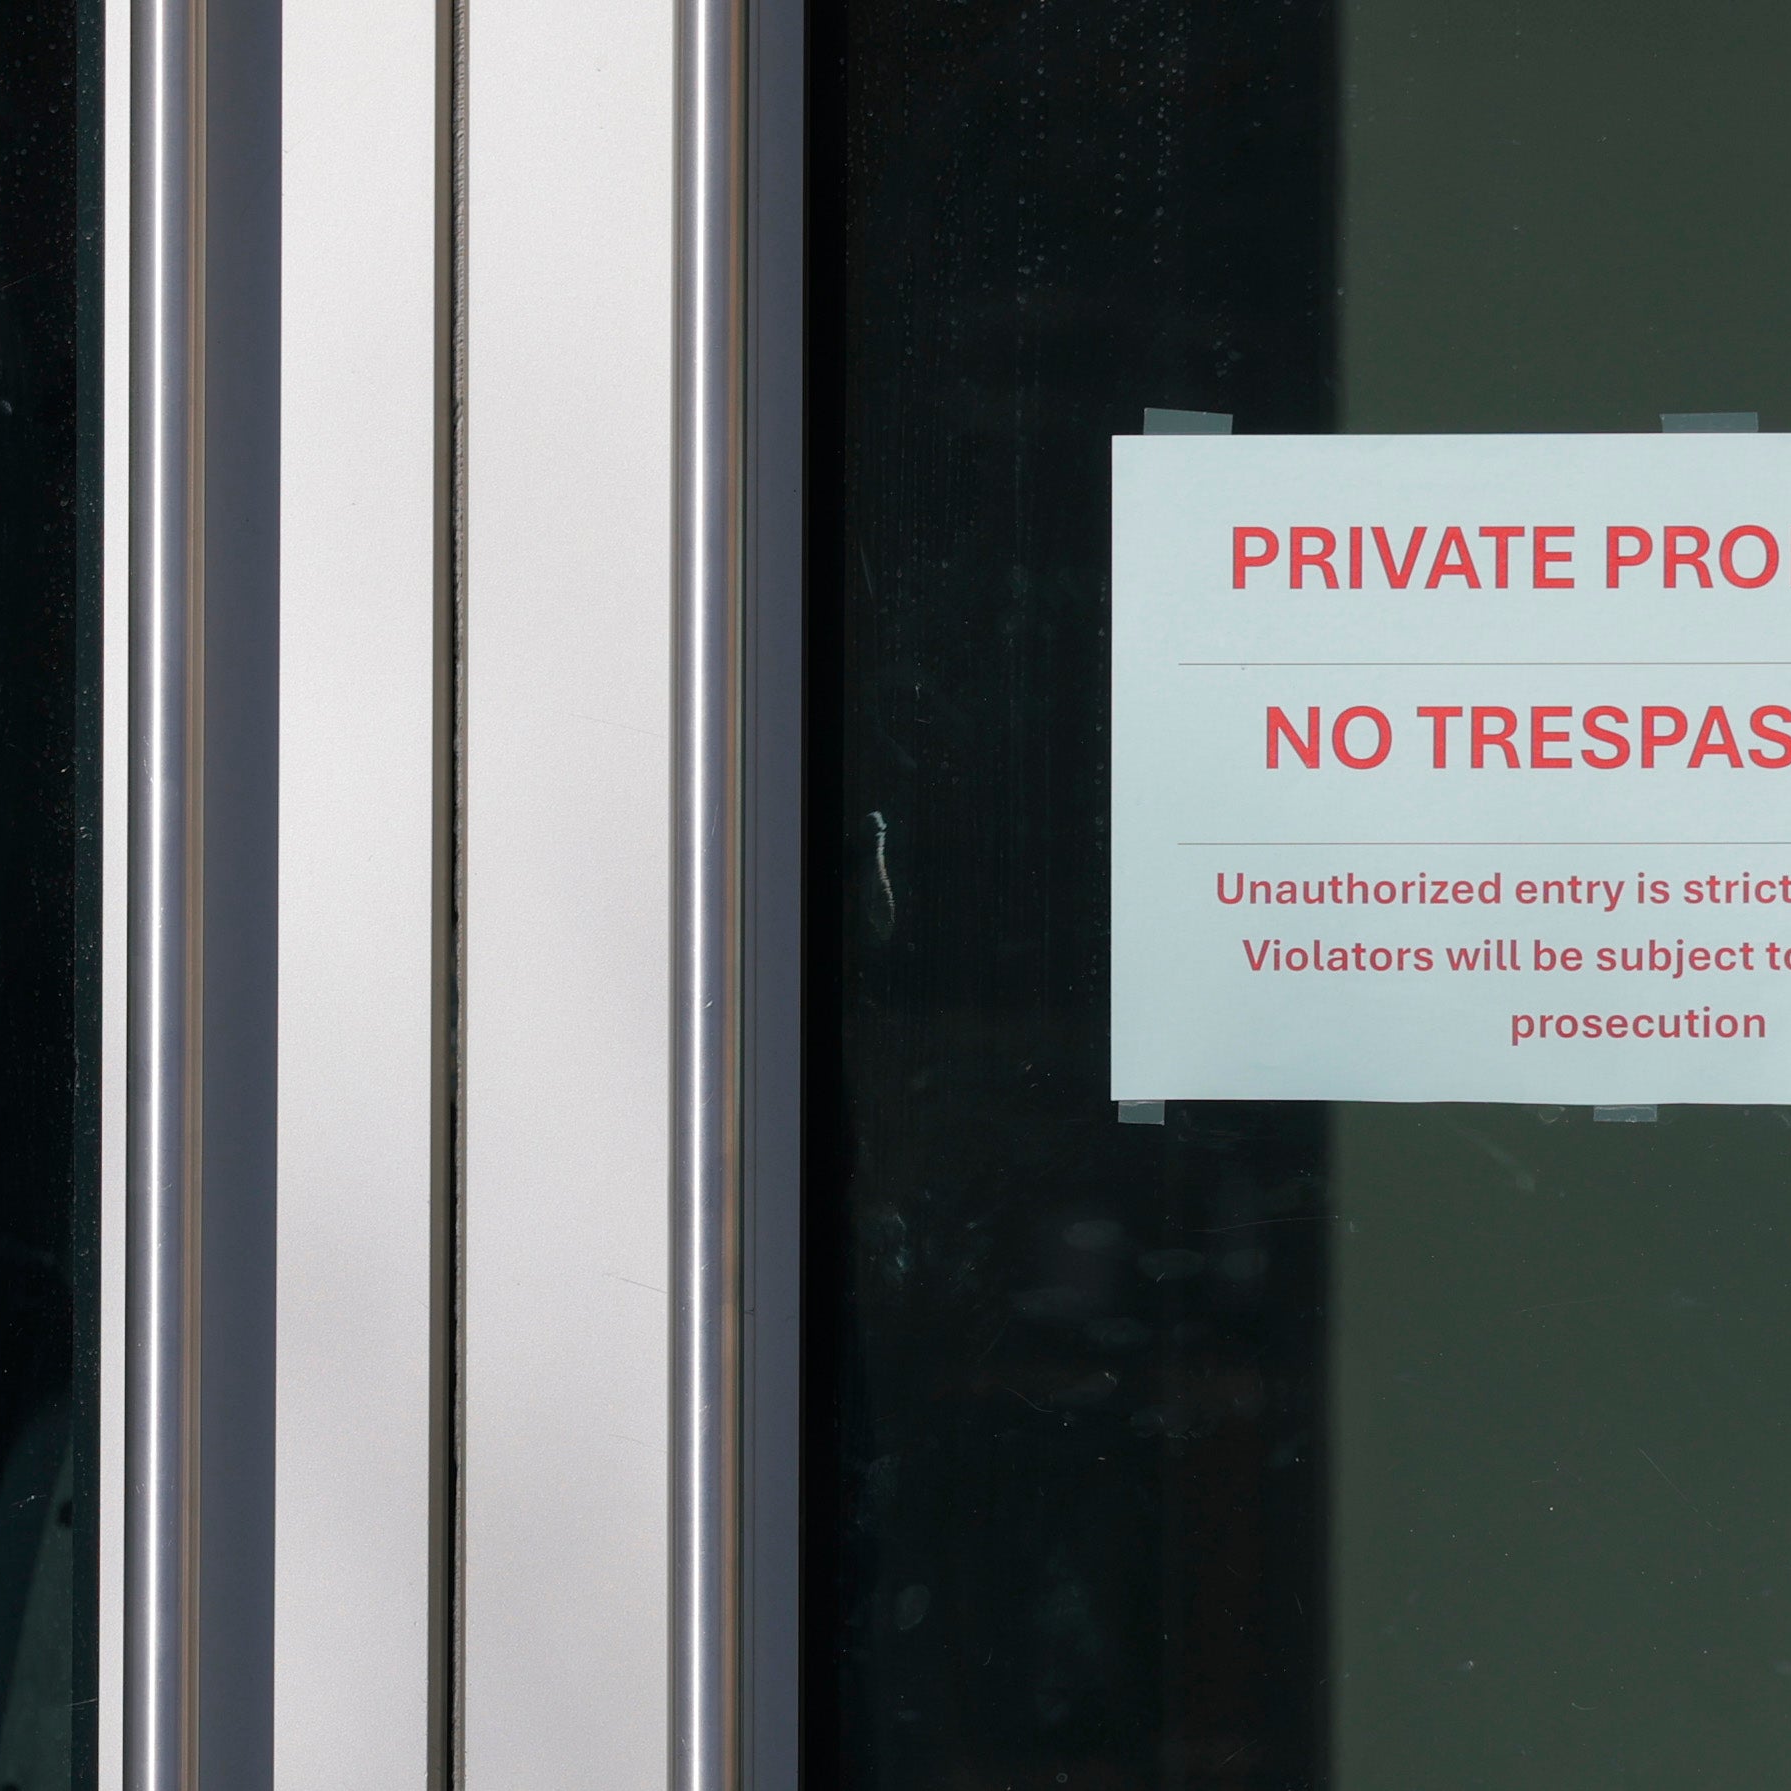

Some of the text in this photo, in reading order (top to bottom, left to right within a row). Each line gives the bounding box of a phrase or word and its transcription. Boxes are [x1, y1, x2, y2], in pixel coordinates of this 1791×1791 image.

[1231, 525, 1576, 591] PRIVATE
[1265, 705, 1394, 771] NO
[1216, 872, 1502, 906] Unauthorized
[1514, 875, 1626, 913] entry
[1636, 872, 1671, 905] is
[1242, 939, 1435, 972] Violators
[1446, 938, 1521, 971] will
[1533, 939, 1584, 972] be
[1595, 938, 1755, 980] subject
[1511, 1006, 1767, 1047] prosecution
